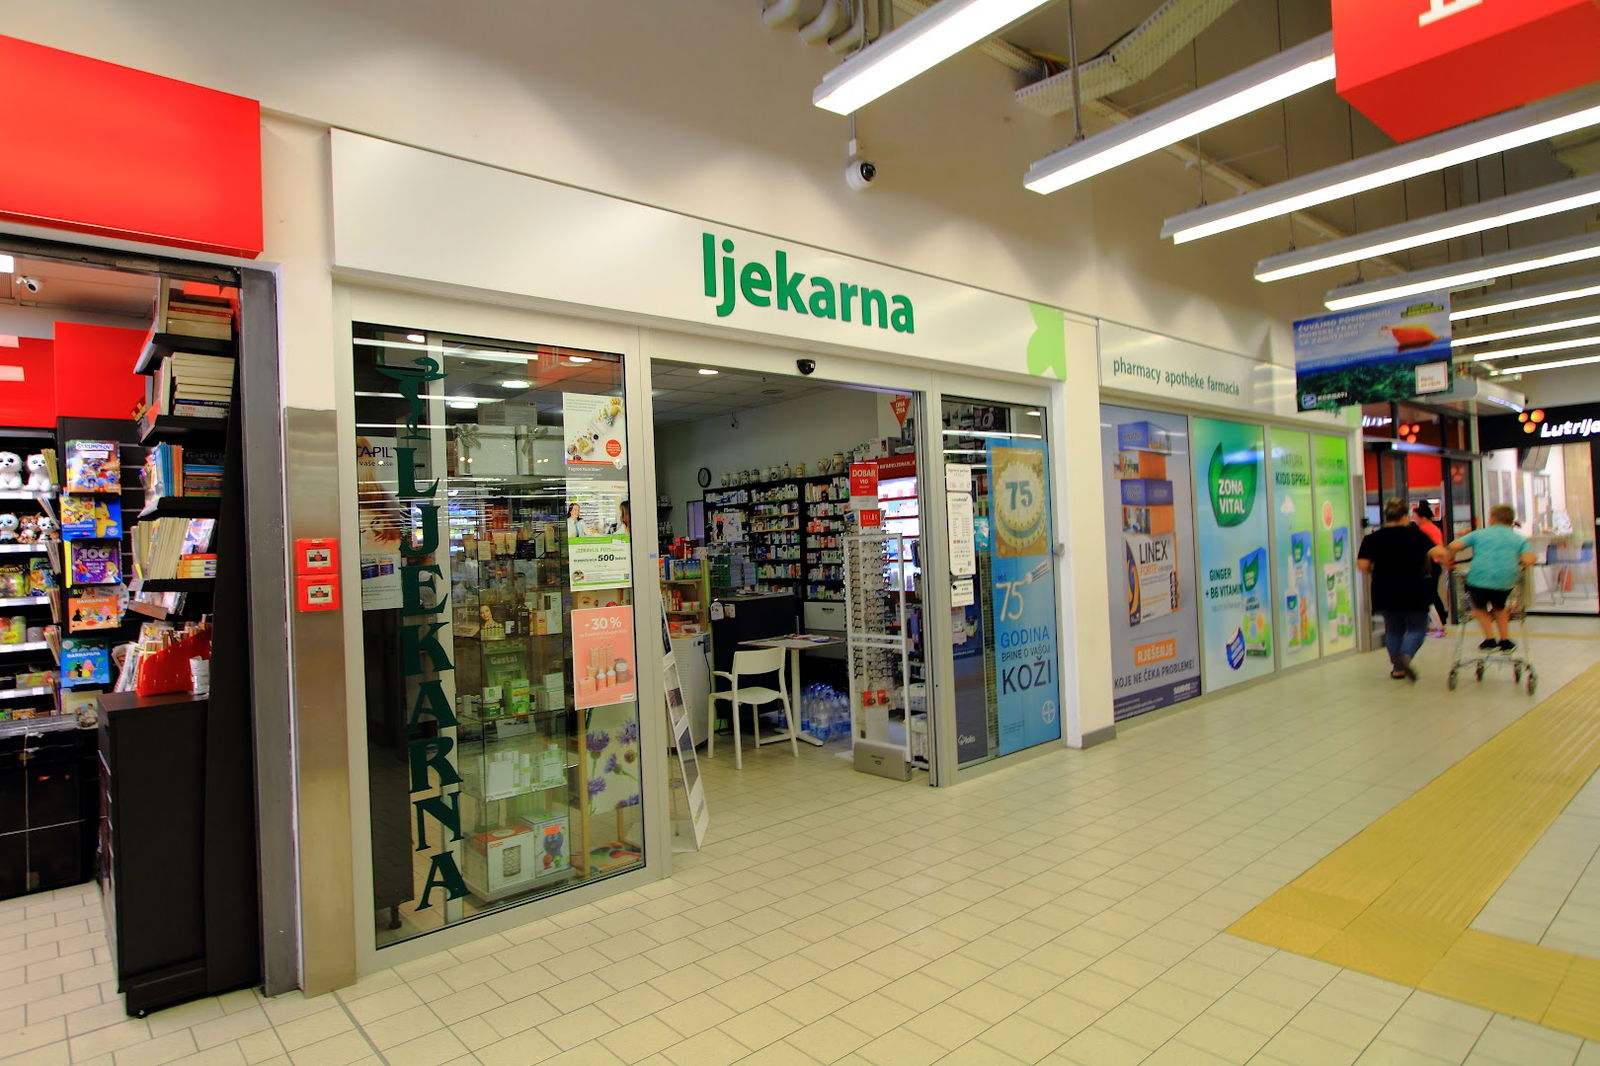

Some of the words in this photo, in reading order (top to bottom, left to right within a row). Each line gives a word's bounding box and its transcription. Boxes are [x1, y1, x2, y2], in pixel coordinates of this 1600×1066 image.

[702, 232, 915, 334] ljekarna
[1113, 357, 1161, 384] pharmacy
[1165, 371, 1204, 389] apotheke
[1207, 375, 1240, 396] farmacia
[1540, 418, 1600, 438] Lutrija
[852, 469, 876, 478] DOBAR
[1005, 480, 1033, 510] 75
[1218, 478, 1244, 496] ZONA
[1219, 498, 1246, 514] VITAL
[598, 554, 615, 562] 500
[1139, 540, 1169, 565] LINEX
[1209, 567, 1232, 581] GINGER
[1219, 583, 1244, 597] VITAMIN
[996, 581, 1025, 622] 75
[1000, 626, 1050, 649] GODINA
[1001, 649, 1022, 662] BRINE
[1023, 648, 1029, 658] O
[1137, 642, 1174, 662] RJEŠENJE
[393, 447, 472, 912] LJEKARNA
[1002, 656, 1052, 695] KOŽI
[1114, 674, 1133, 689] KOJE
[1133, 672, 1143, 684] NE
[1143, 667, 1160, 681] ČEKA
